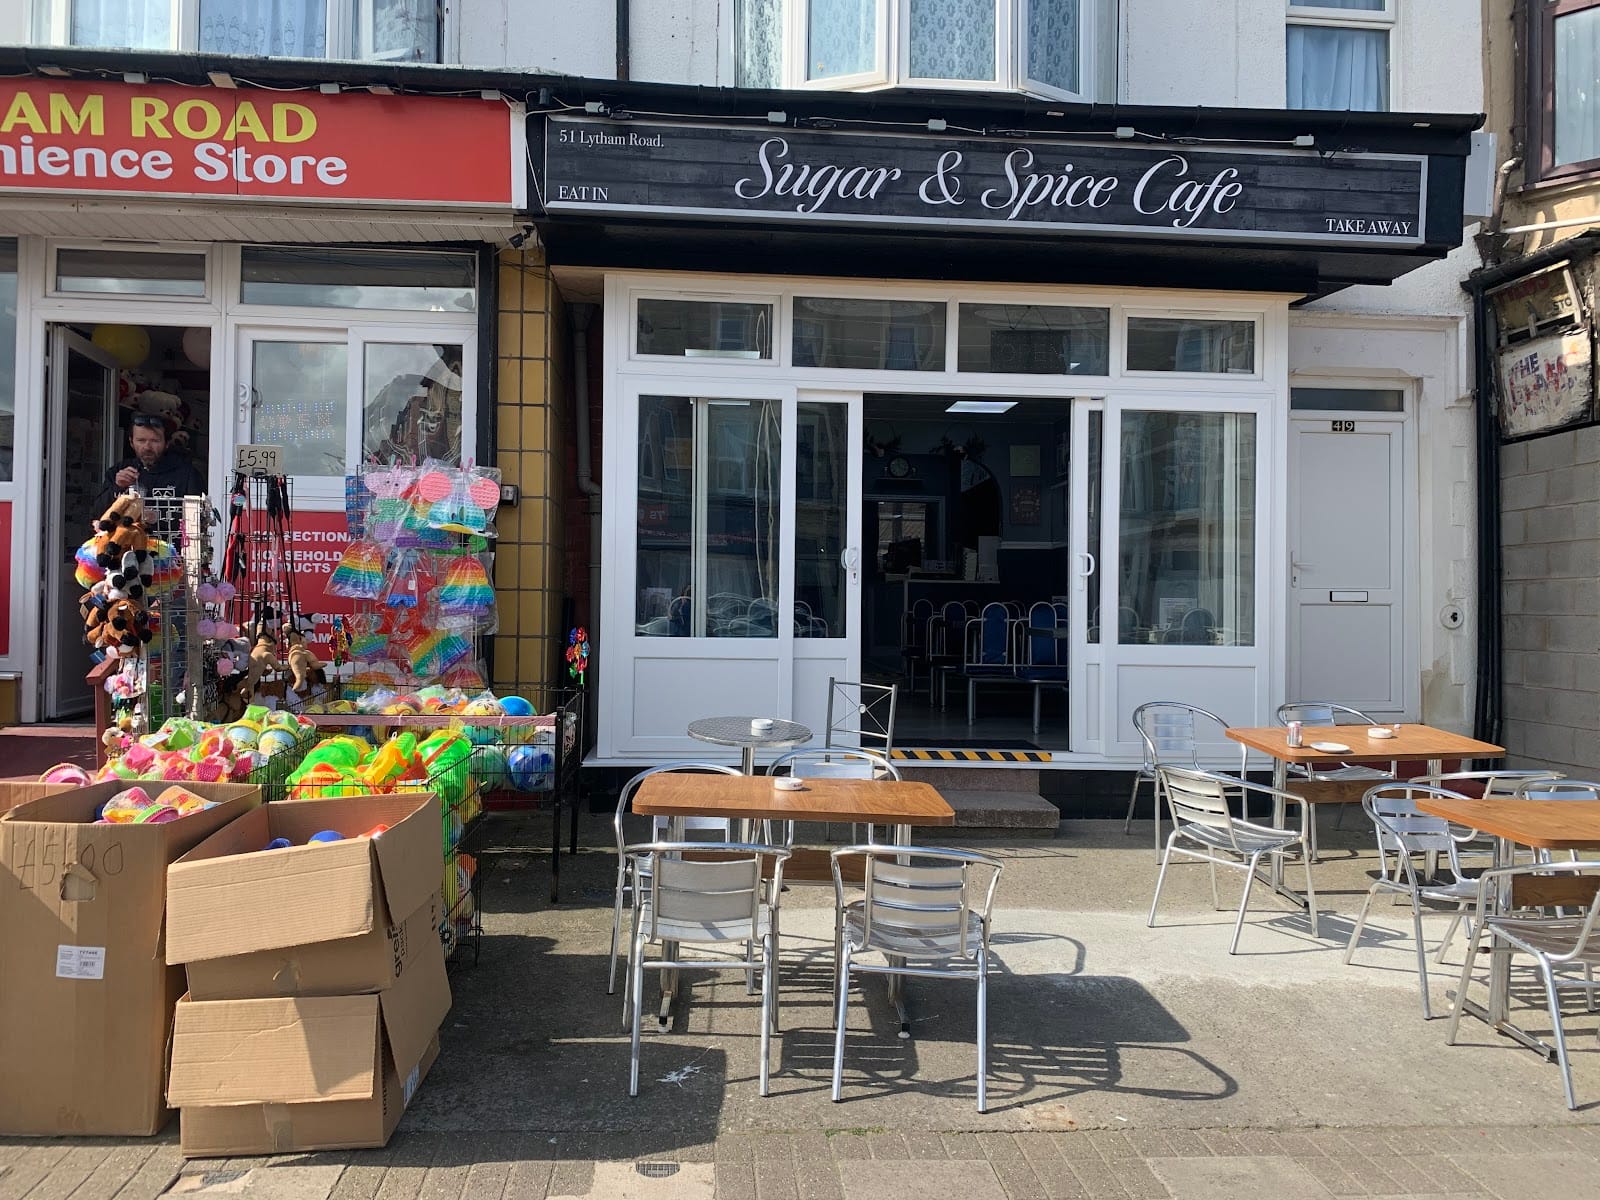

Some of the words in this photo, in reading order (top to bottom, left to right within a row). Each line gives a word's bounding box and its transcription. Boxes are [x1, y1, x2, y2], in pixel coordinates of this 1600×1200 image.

[0, 91, 104, 136] AM
[131, 96, 317, 144] ROAD
[559, 129, 576, 145] 51
[579, 130, 626, 148] Lytham
[628, 132, 665, 148] Road.
[194, 142, 348, 186] Store
[734, 136, 901, 214] Sugar
[918, 149, 966, 206] &
[979, 147, 1119, 221] Spice
[1132, 154, 1243, 229] Cafe
[558, 185, 591, 201] EAT
[592, 186, 609, 202] IN
[1332, 420, 1355, 432] 49
[238, 449, 276, 469] £5.99
[251, 562, 331, 574] PRDUCTS
